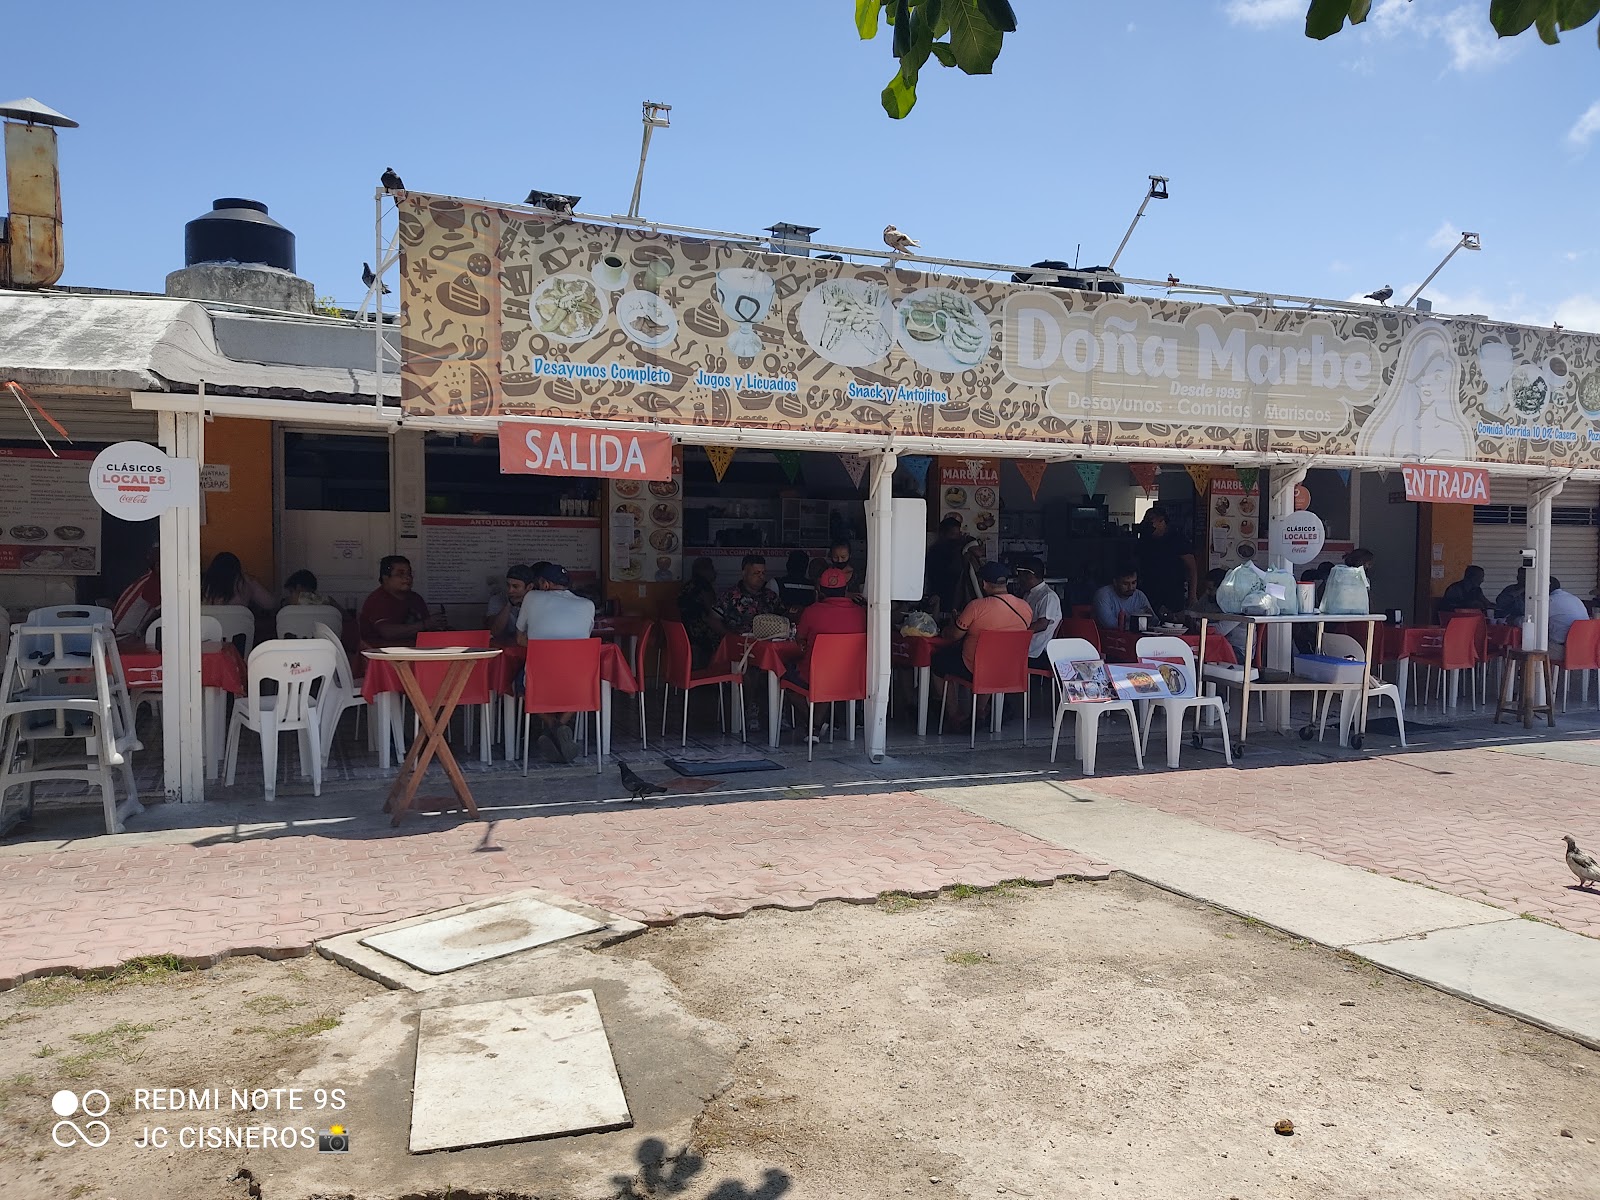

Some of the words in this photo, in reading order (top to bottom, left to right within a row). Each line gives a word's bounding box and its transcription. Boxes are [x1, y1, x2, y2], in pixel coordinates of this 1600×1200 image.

[1017, 308, 1181, 379] Doña
[1198, 324, 1372, 392] Marbe
[534, 358, 606, 379] Desayunos
[611, 363, 670, 384] Completo
[696, 370, 731, 389] Jugos
[734, 377, 742, 390] y
[747, 374, 797, 391] Licuados
[849, 383, 883, 399] Snack
[886, 388, 894, 402] y
[898, 386, 947, 403] Antojitos
[1170, 381, 1213, 397] Desde
[1068, 392, 1162, 417] Desayunos
[1178, 397, 1250, 418] Comidas
[1264, 404, 1332, 422] Mariscos
[1478, 422, 1503, 435] Comida
[1505, 424, 1531, 437] Corrida
[1554, 428, 1577, 440] Casera
[1588, 429, 1600, 441] Poz
[525, 429, 647, 474] SALIDA
[106, 462, 162, 473] CLÁSICOS
[103, 474, 166, 485] LOCALES
[1213, 479, 1259, 490] MARBEA
[1402, 467, 1487, 499] ENTRADA
[470, 519, 511, 527] ANTOJITOS
